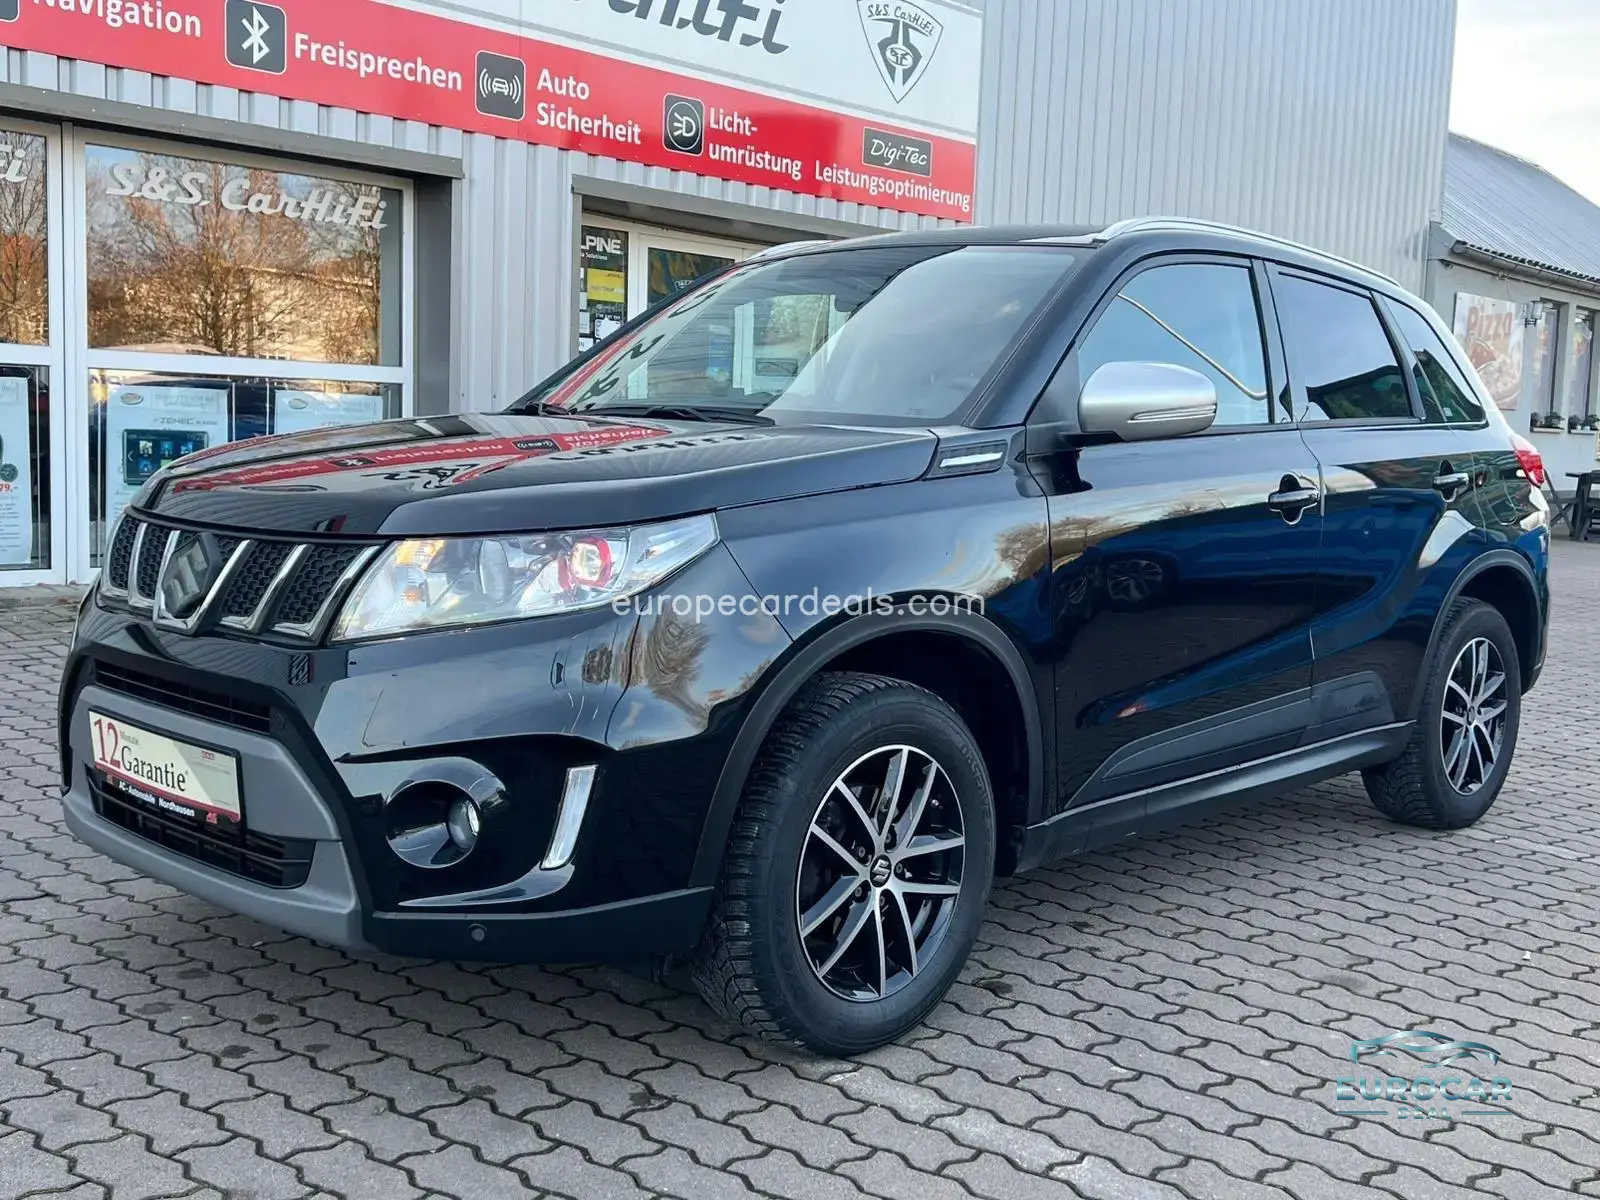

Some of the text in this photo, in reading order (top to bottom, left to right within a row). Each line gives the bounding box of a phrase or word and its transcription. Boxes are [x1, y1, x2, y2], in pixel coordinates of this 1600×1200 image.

[294, 32, 462, 91] Freisprechen
[536, 68, 590, 100] Auto
[536, 102, 641, 144] Sicherheit
[709, 107, 758, 137] Licht-
[709, 143, 802, 181] umrüstung
[870, 138, 928, 166] Digi-Tec
[220, 178, 389, 230] CarHiFi
[815, 159, 970, 212] Leistungsoptimierung
[1468, 306, 1513, 335] Pizza
[94, 718, 121, 769] 12
[121, 745, 187, 792] Garantie
[158, 797, 195, 817] Nordhausen
